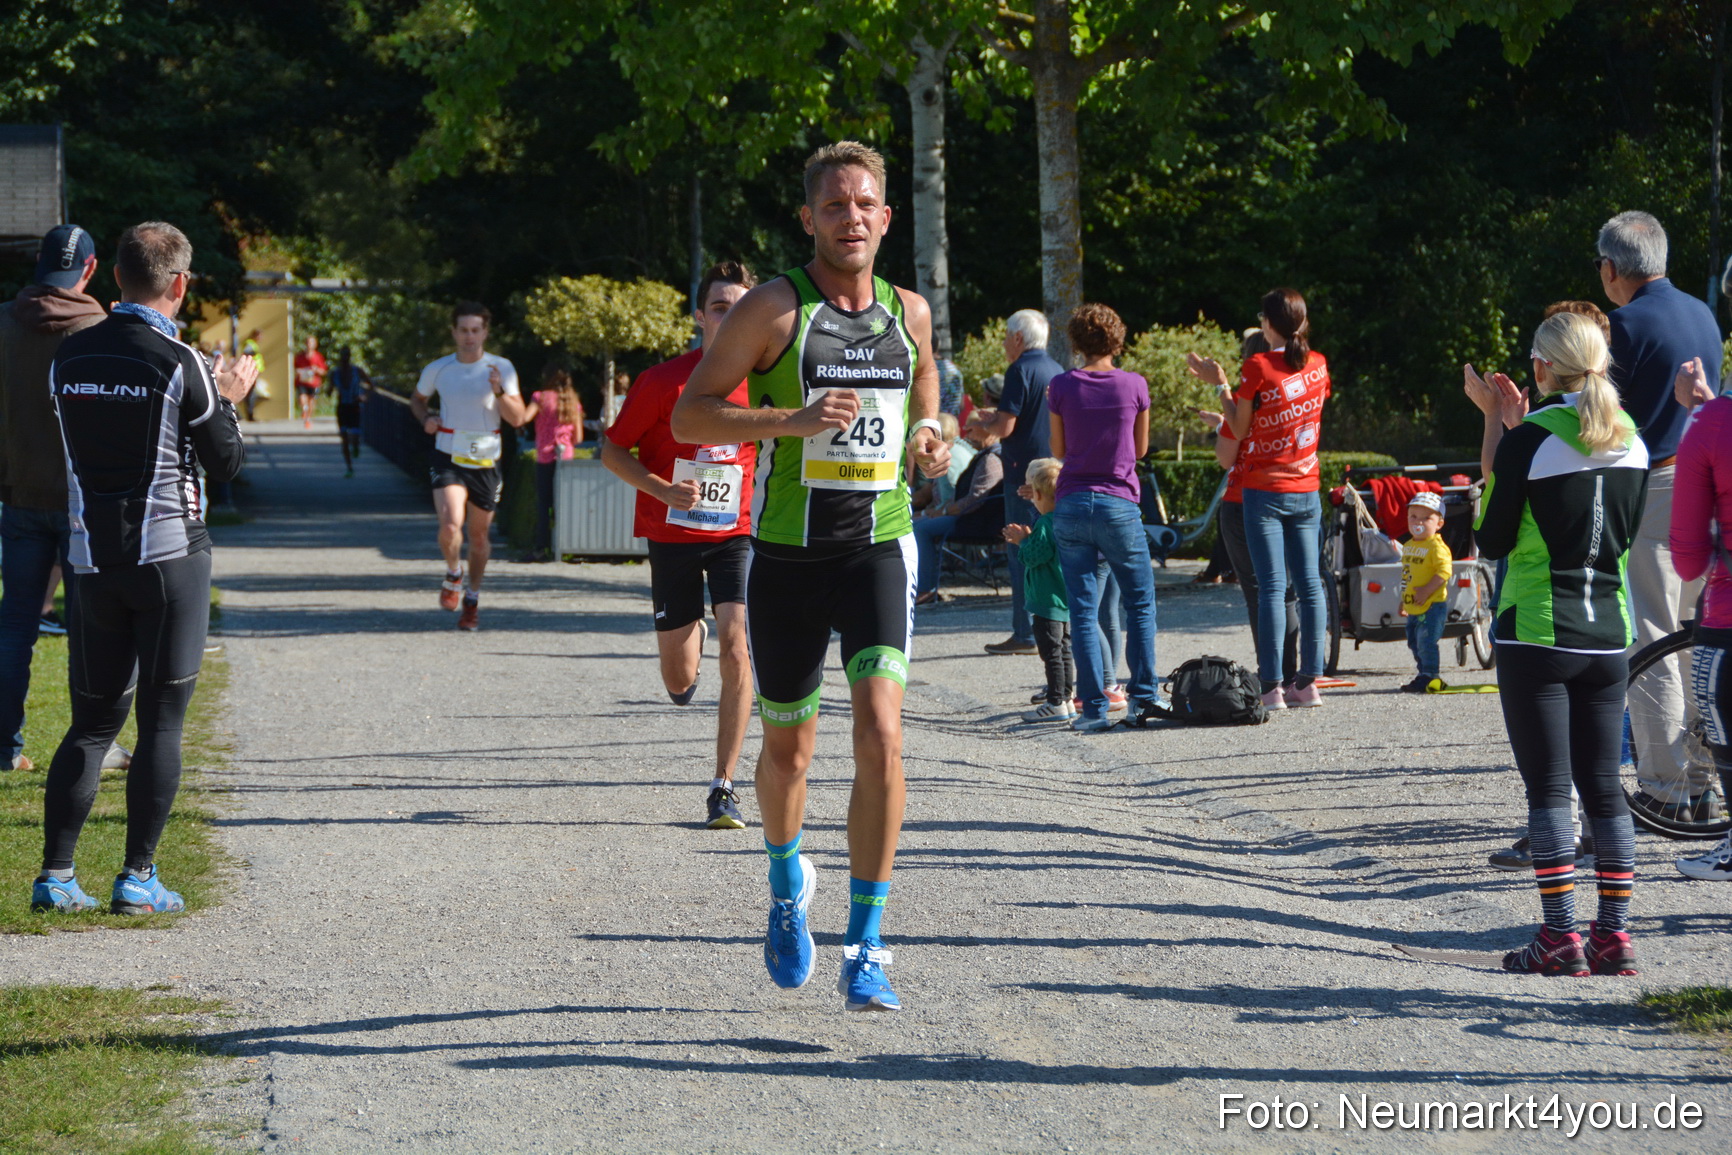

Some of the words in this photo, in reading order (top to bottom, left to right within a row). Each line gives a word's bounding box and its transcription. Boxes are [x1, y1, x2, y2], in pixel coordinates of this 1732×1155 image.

[844, 349, 875, 361] DAV
[816, 365, 904, 380] Röthenbach
[470, 442, 477, 454] 5
[826, 450, 848, 458] PARTL
[850, 450, 880, 459] Neumarkt
[839, 464, 874, 478] Oliver
[699, 481, 731, 503] 462
[687, 511, 719, 523] Michael
